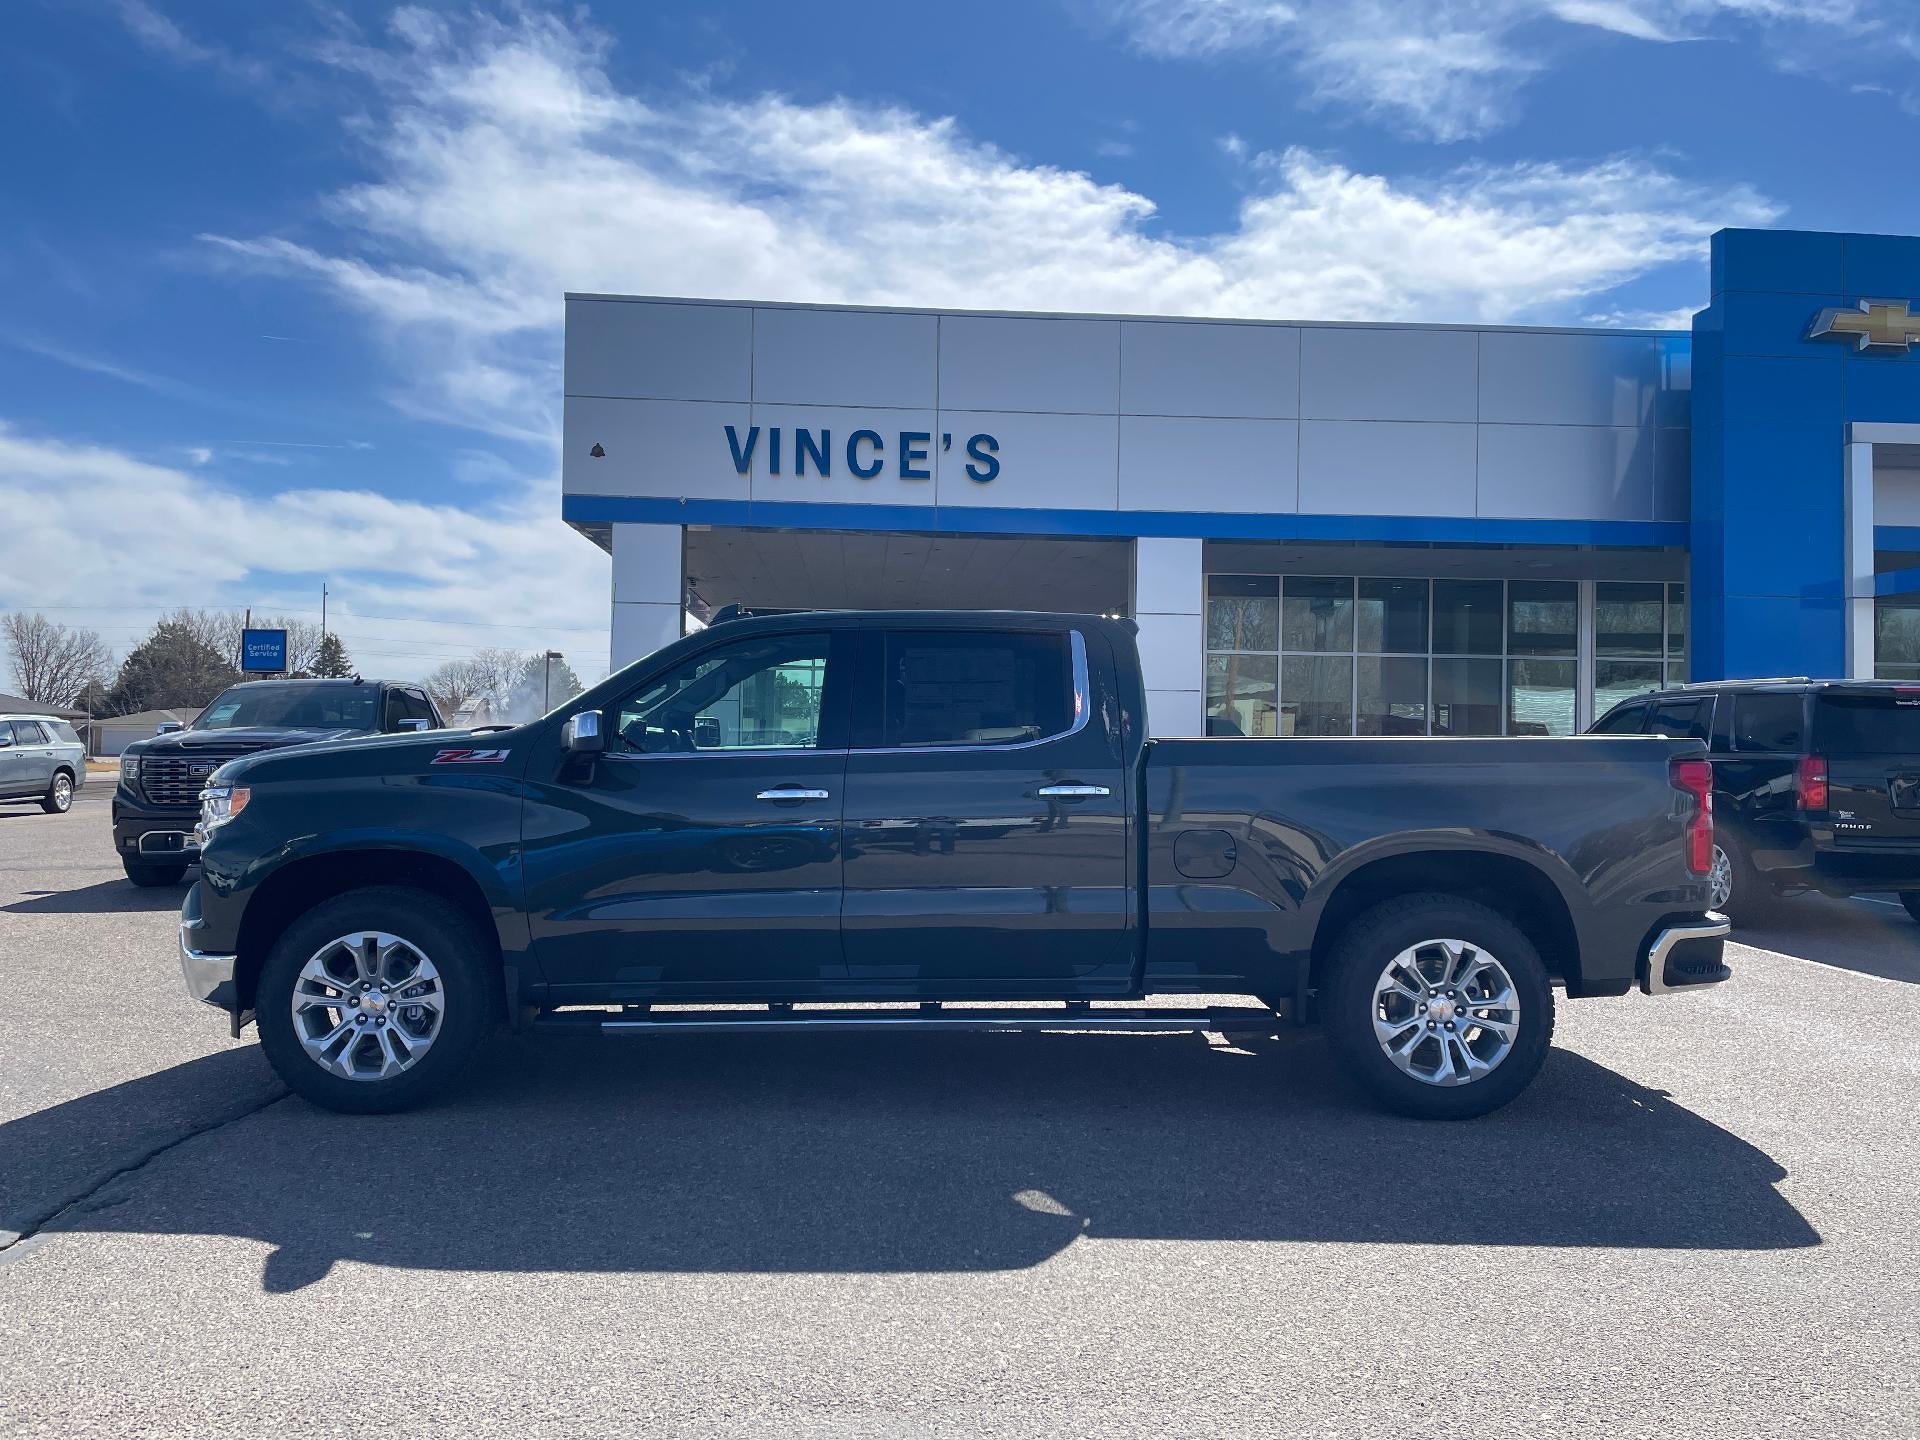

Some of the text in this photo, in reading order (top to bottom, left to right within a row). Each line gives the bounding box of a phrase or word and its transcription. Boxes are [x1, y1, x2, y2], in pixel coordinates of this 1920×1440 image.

[724, 425, 1001, 483] VINCE'S
[247, 643, 280, 651] Certified
[430, 749, 512, 765] Z71
